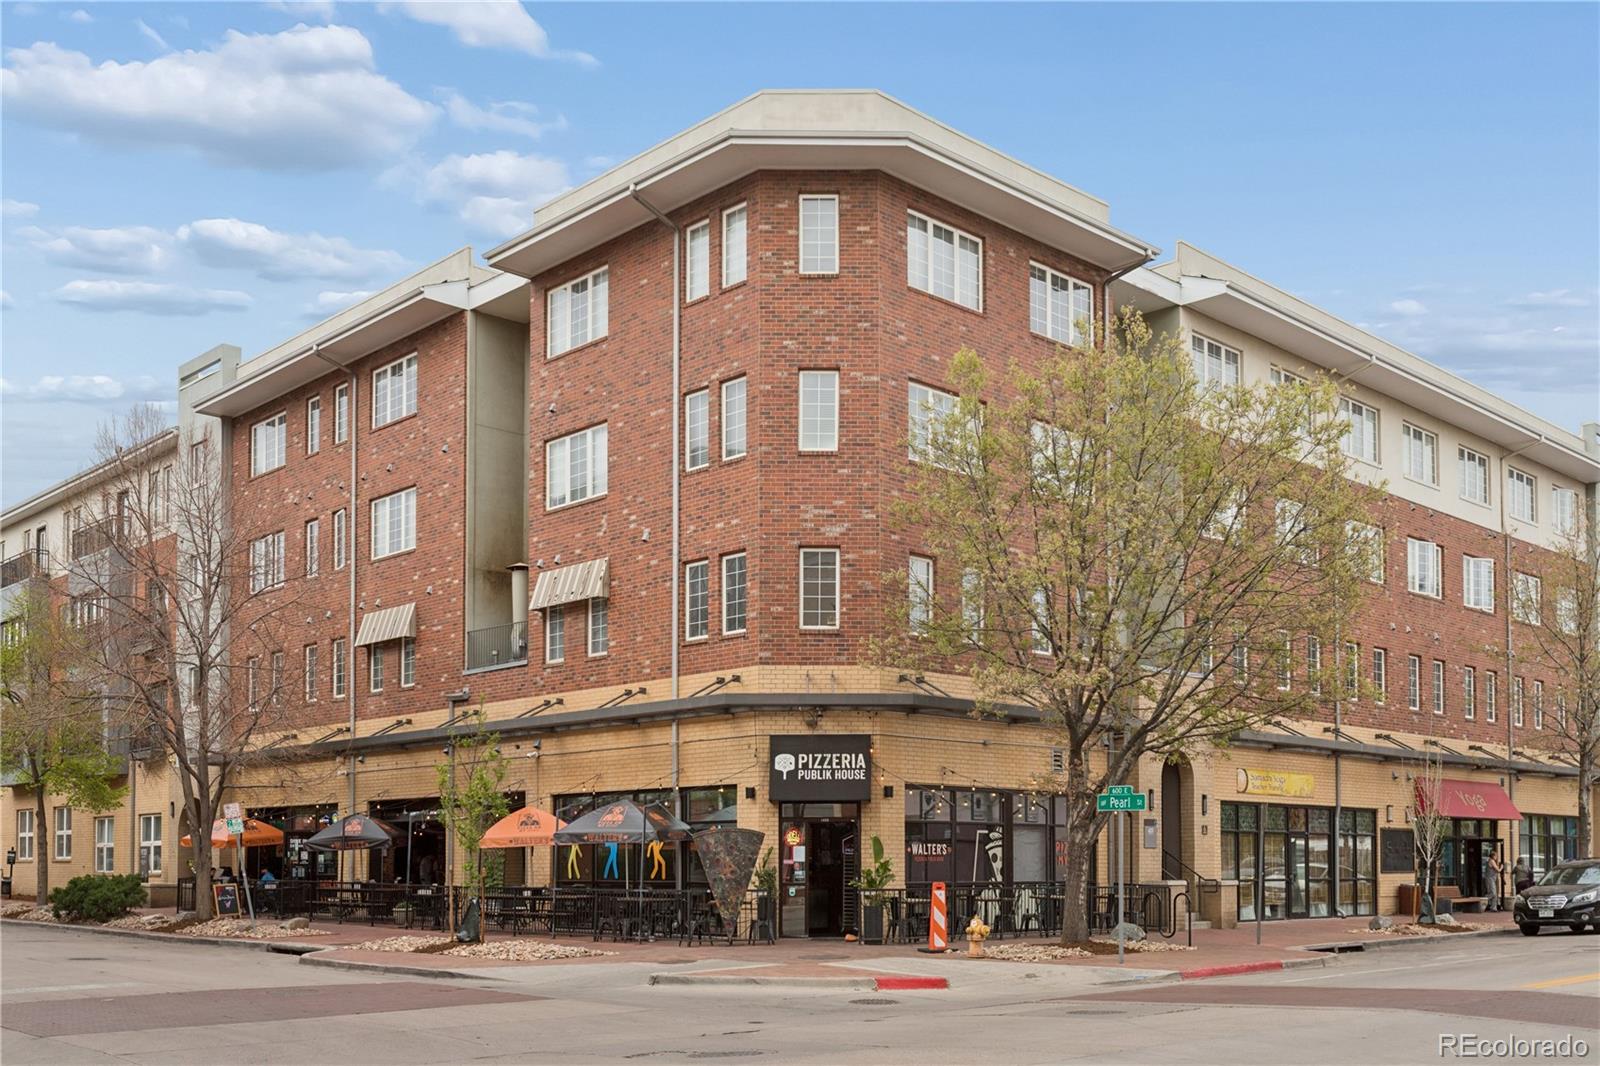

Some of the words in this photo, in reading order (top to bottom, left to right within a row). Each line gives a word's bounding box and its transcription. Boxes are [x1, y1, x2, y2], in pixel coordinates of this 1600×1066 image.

[798, 753, 866, 769] PIZZERIA
[798, 769, 832, 780] PUBLIK
[834, 769, 866, 780] HOUSE
[1110, 796, 1131, 809] Pearl
[1455, 790, 1487, 812] Yoga
[911, 843, 948, 855] WALTER'S
